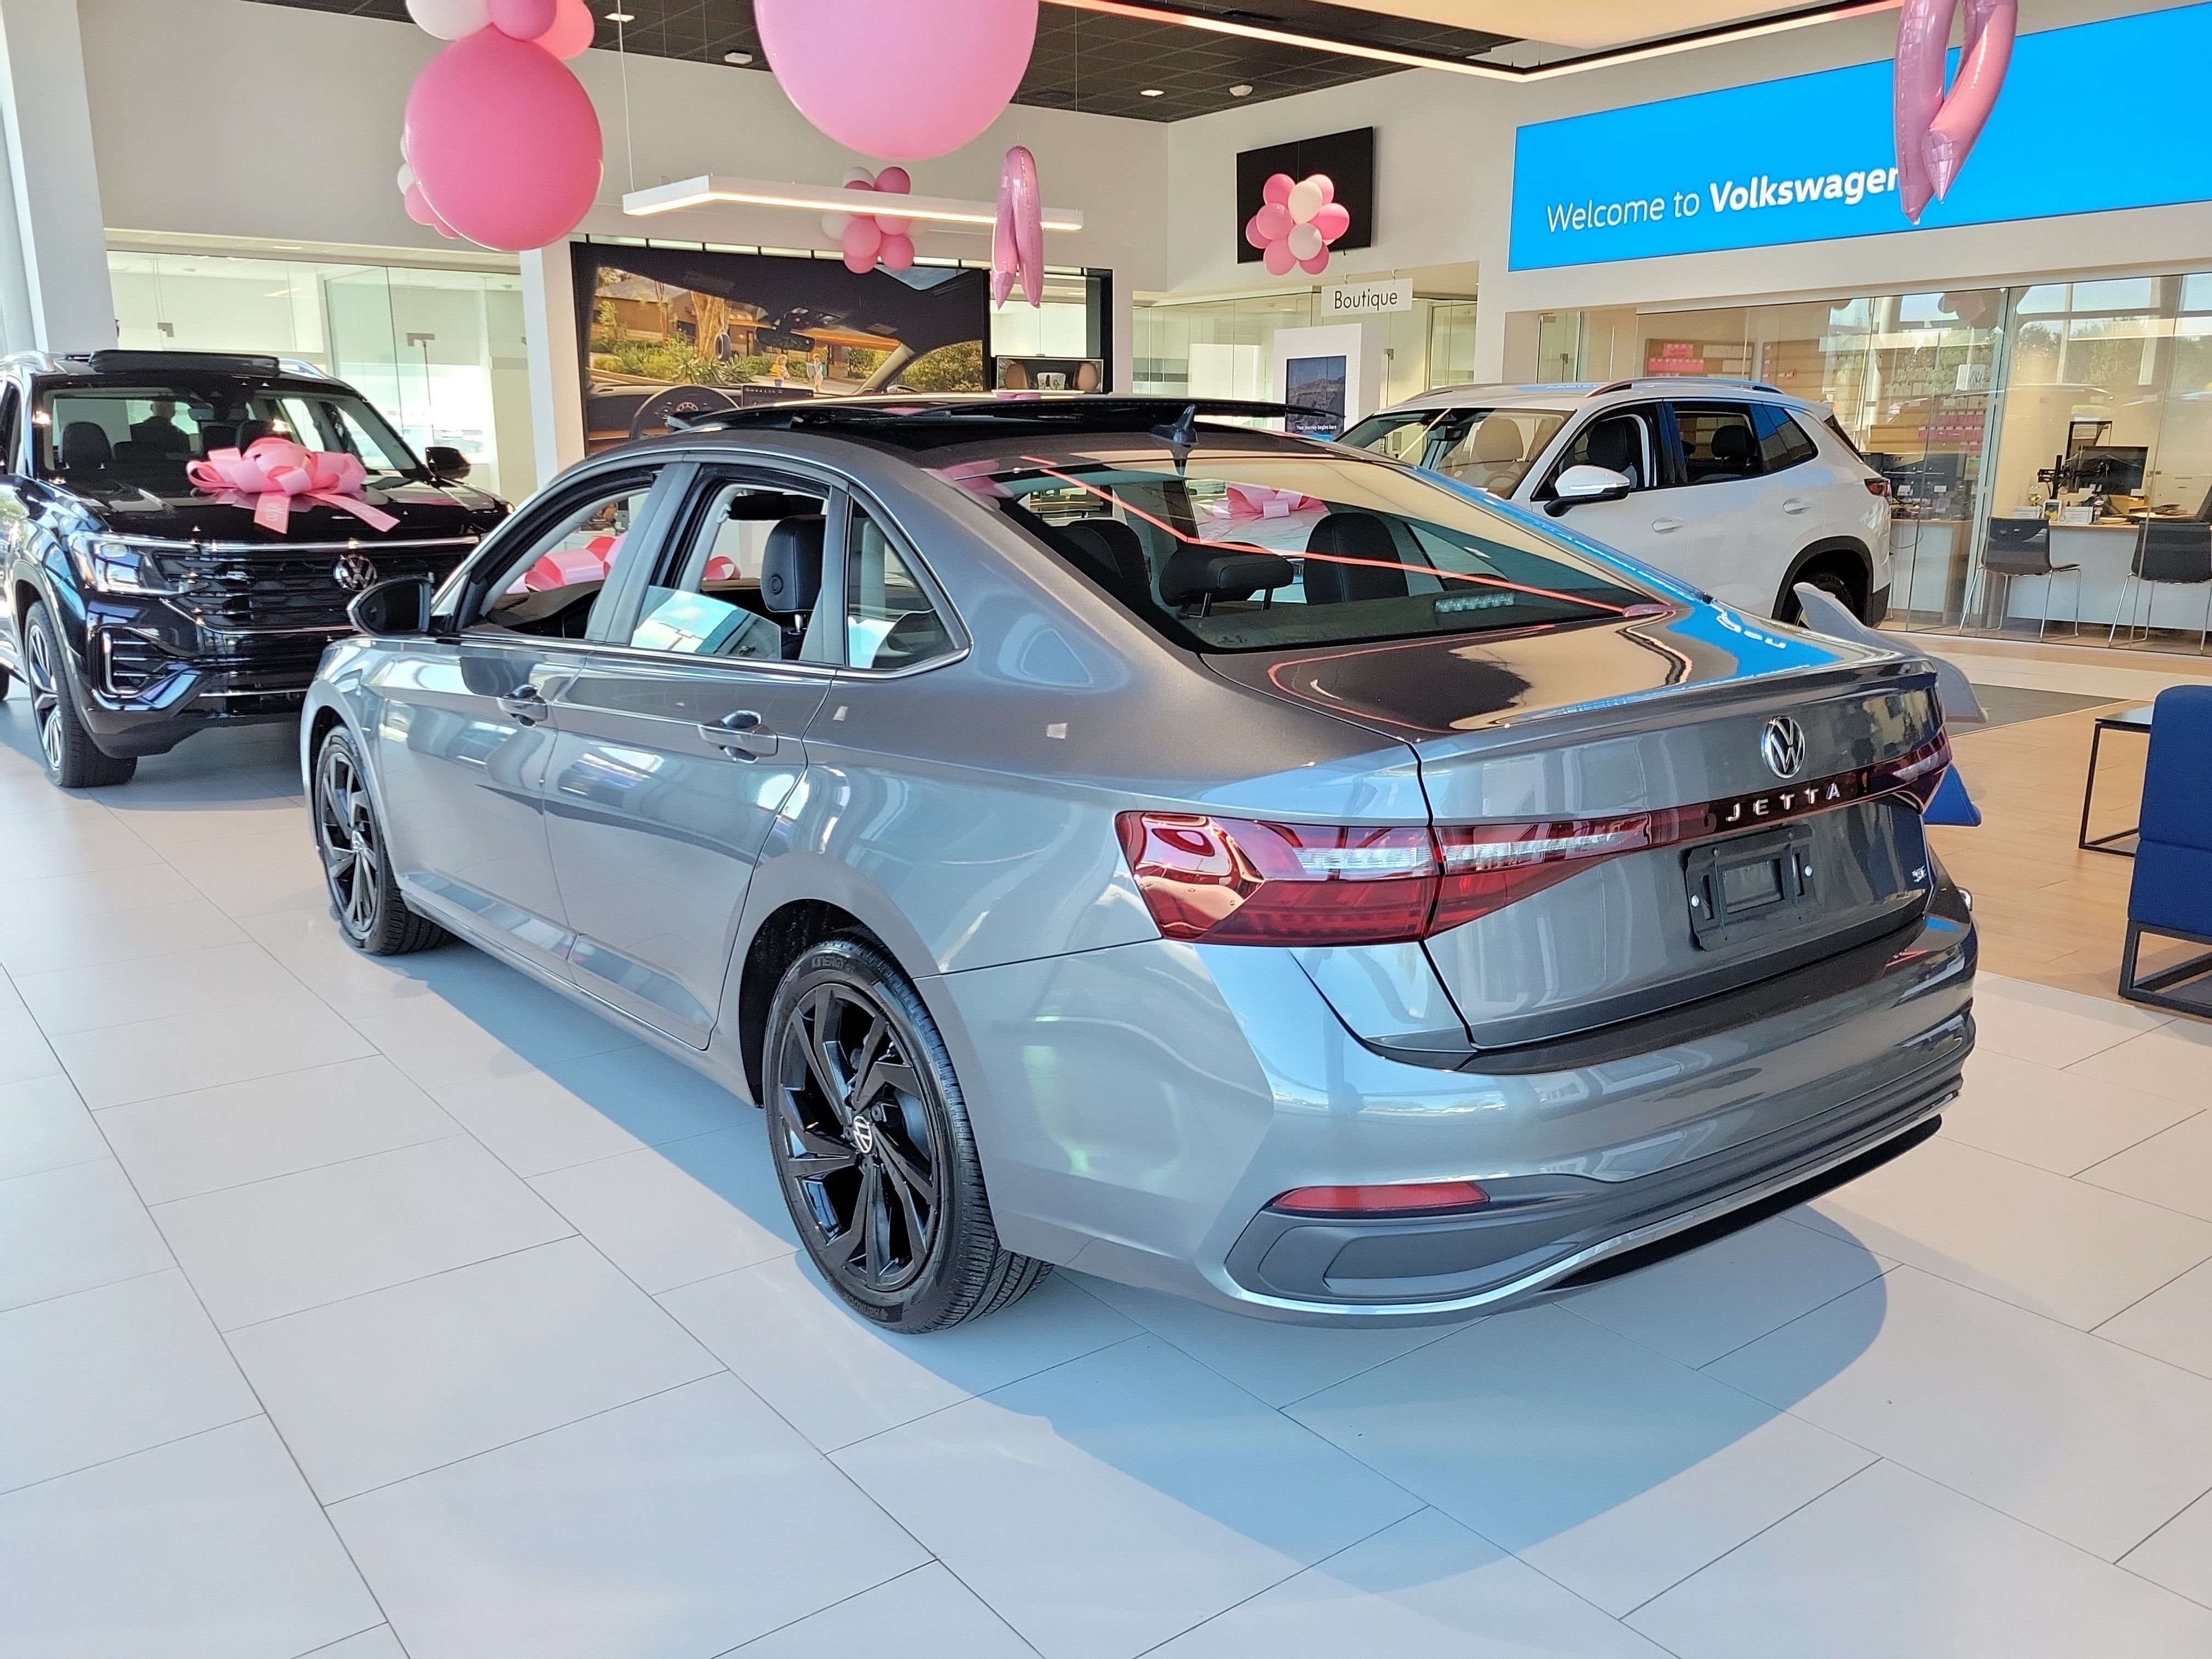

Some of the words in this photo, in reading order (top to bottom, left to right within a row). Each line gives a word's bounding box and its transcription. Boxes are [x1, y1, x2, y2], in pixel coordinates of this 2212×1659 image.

[1547, 199, 1665, 233] Welcome
[1673, 191, 1700, 218] to
[1335, 289, 1397, 311] Boutique
[1726, 782, 1841, 822] JETTA
